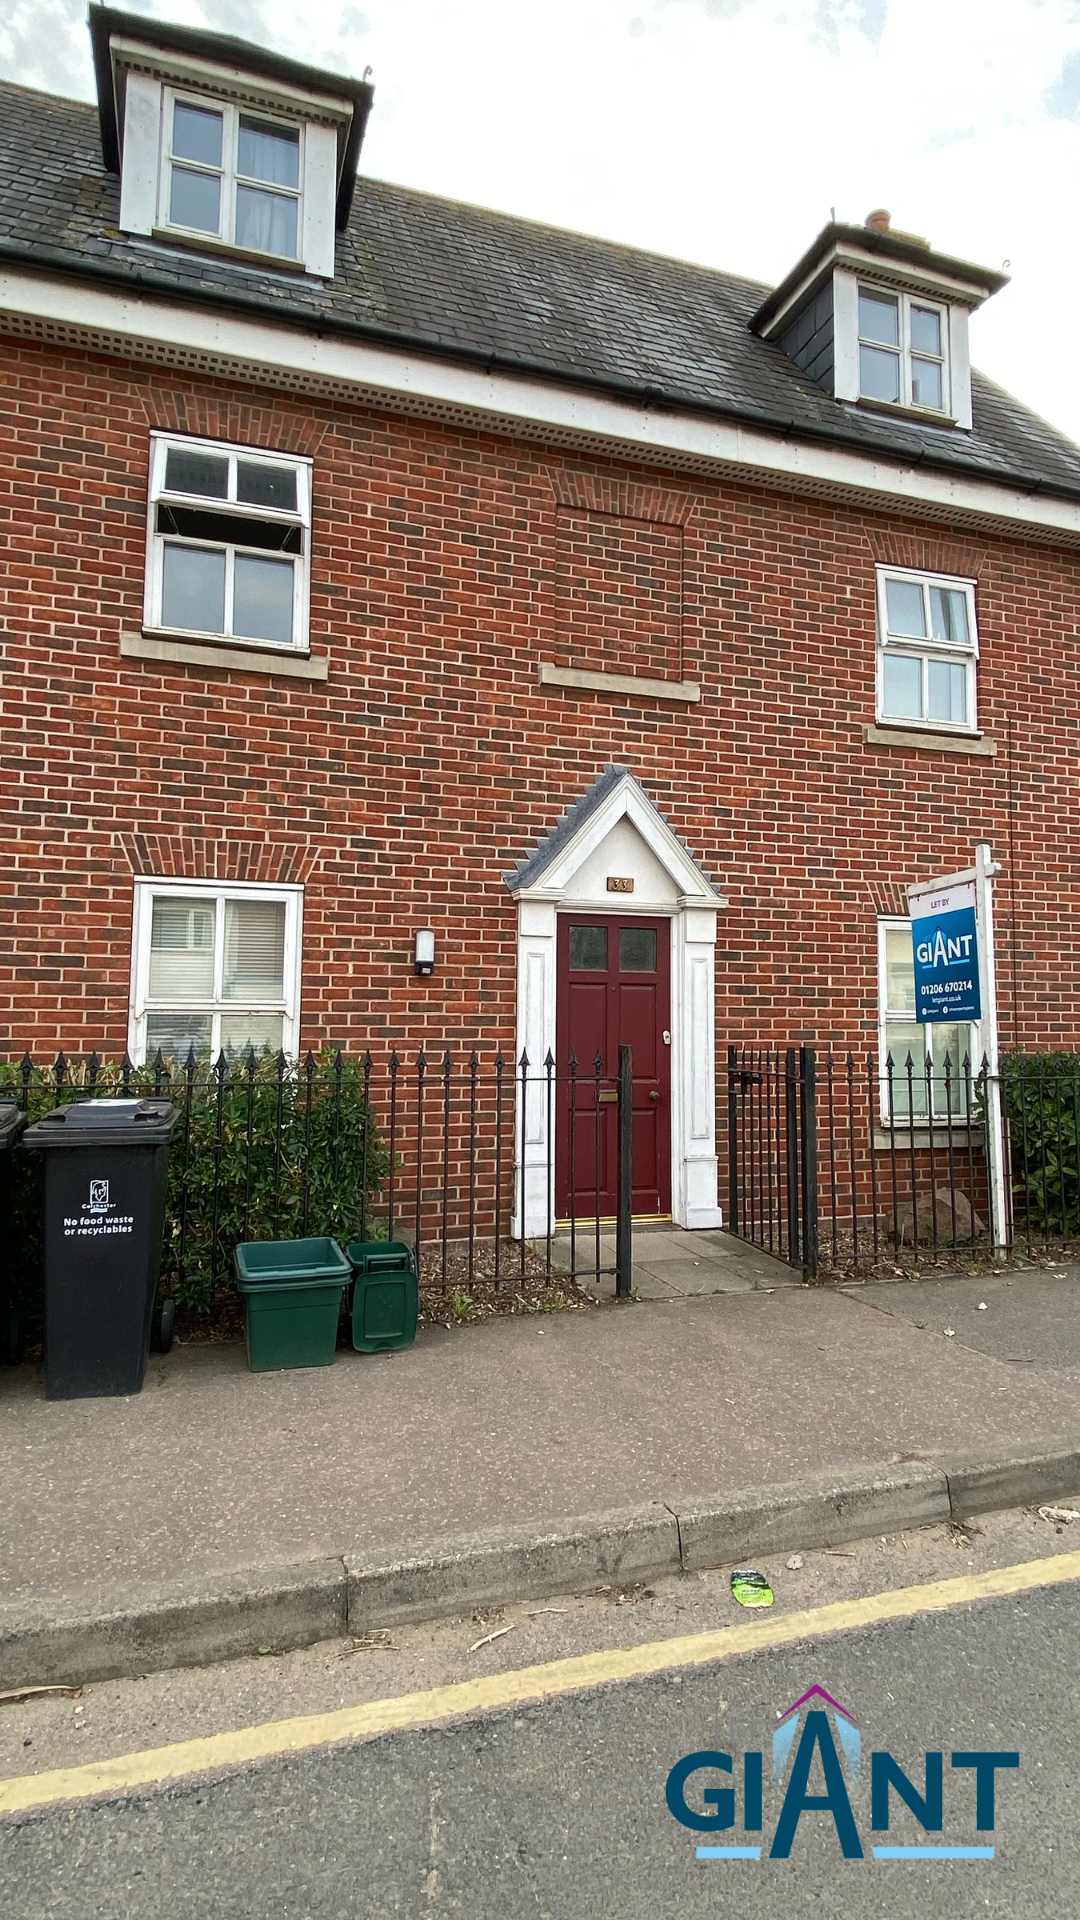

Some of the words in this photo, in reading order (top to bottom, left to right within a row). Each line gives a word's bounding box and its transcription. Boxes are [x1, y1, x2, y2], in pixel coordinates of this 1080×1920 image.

[612, 879, 629, 891] 33
[931, 900, 941, 909] LET
[942, 898, 950, 907] BY
[916, 930, 973, 968] GIANT
[921, 983, 943, 995] 01206
[944, 980, 973, 993] 670214
[931, 994, 962, 1005] letgiant.co.uk
[63, 1218, 78, 1226] No
[80, 1216, 103, 1226] food
[105, 1216, 134, 1224] waste
[77, 1225, 133, 1236] recyclables
